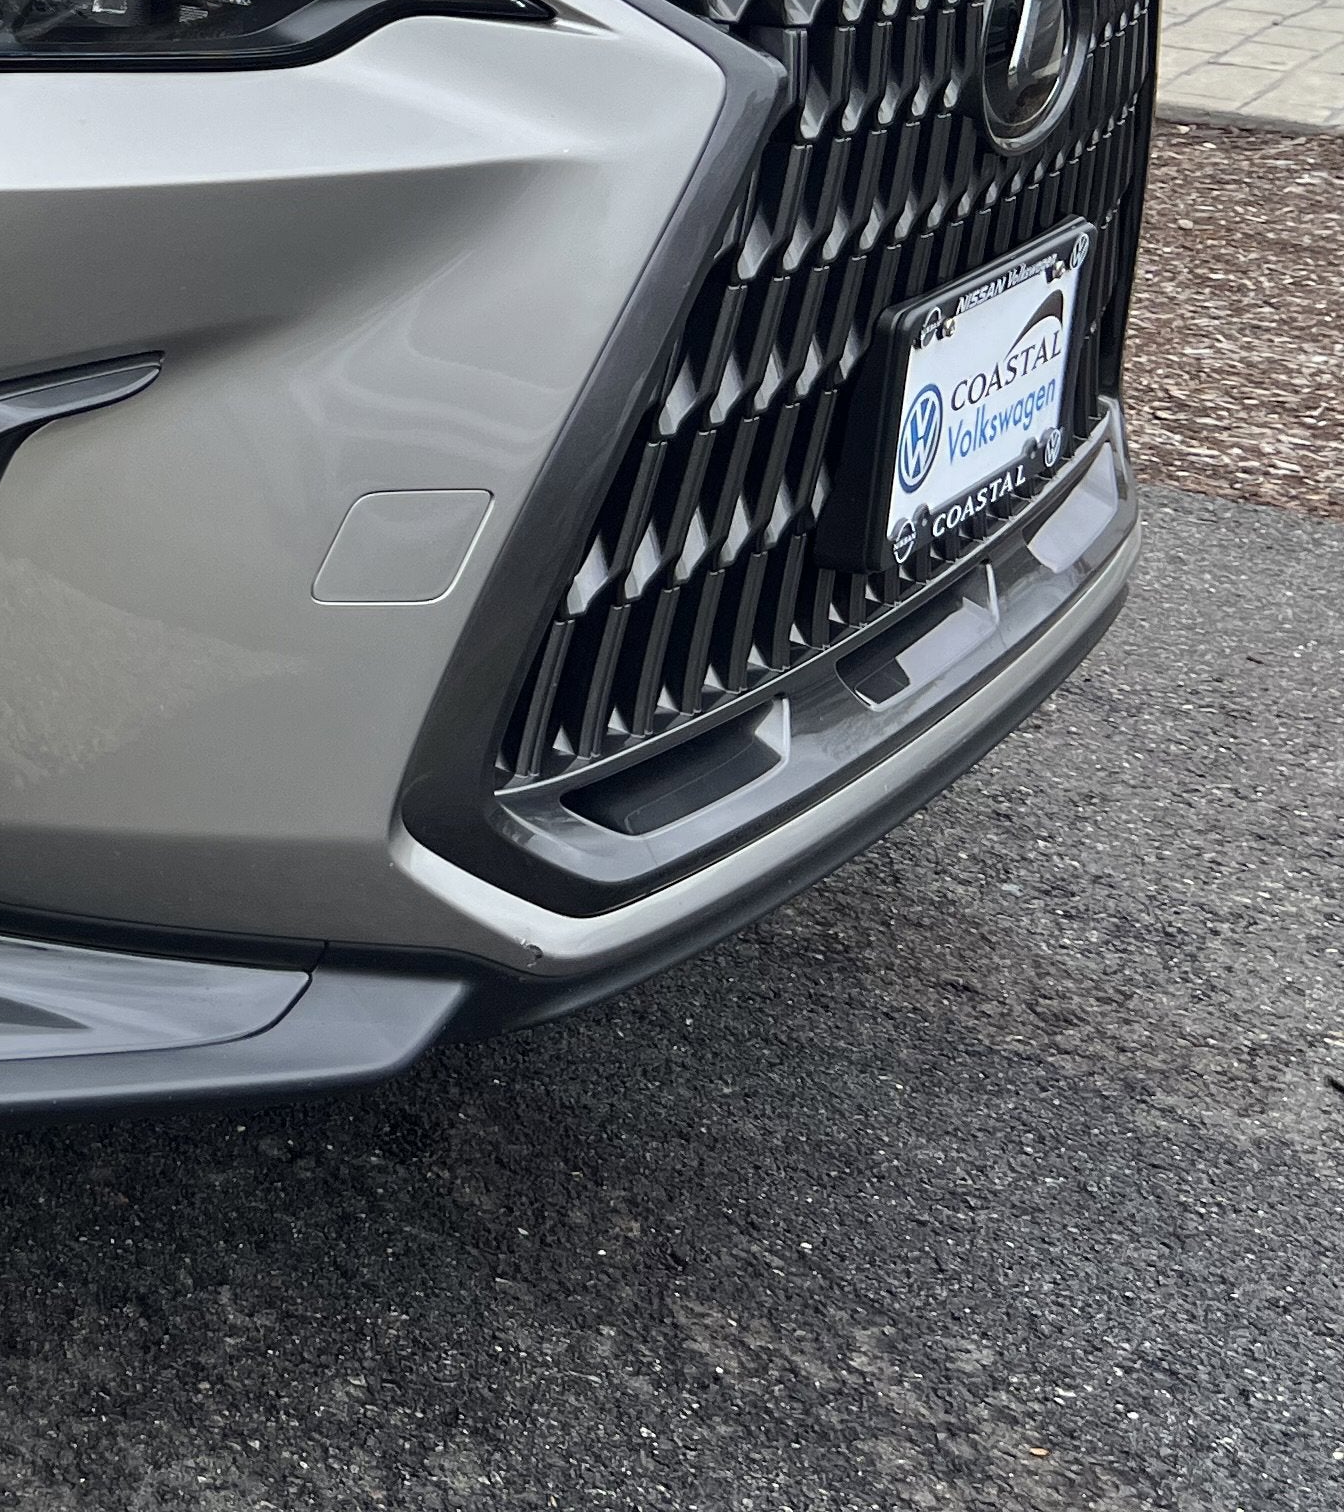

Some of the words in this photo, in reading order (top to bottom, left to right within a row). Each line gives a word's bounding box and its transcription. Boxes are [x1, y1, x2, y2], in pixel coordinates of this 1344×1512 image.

[955, 275, 1007, 316] NISSAN
[950, 329, 1062, 411] COASTAL
[948, 378, 1056, 465] Volkswagen
[932, 464, 1026, 538] COASTAL
